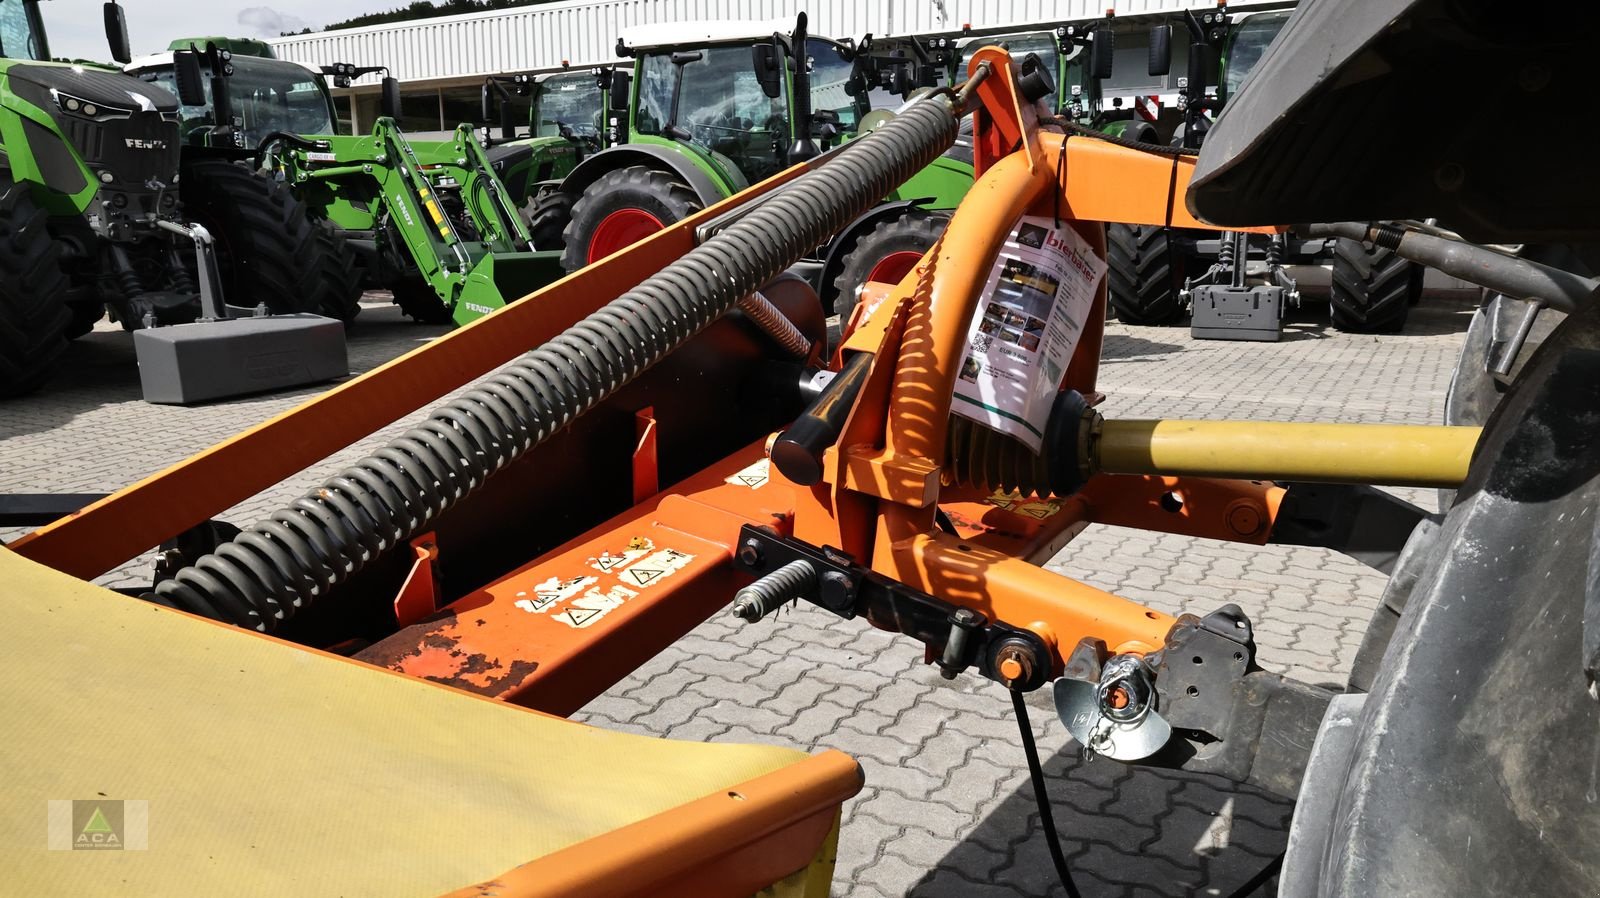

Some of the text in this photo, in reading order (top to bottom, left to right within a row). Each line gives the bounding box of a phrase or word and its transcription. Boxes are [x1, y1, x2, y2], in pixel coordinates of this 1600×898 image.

[125, 138, 167, 149] FEND
[396, 194, 414, 225] FENDT
[1046, 230, 1095, 283] bierbauer
[465, 302, 495, 315] FENDT
